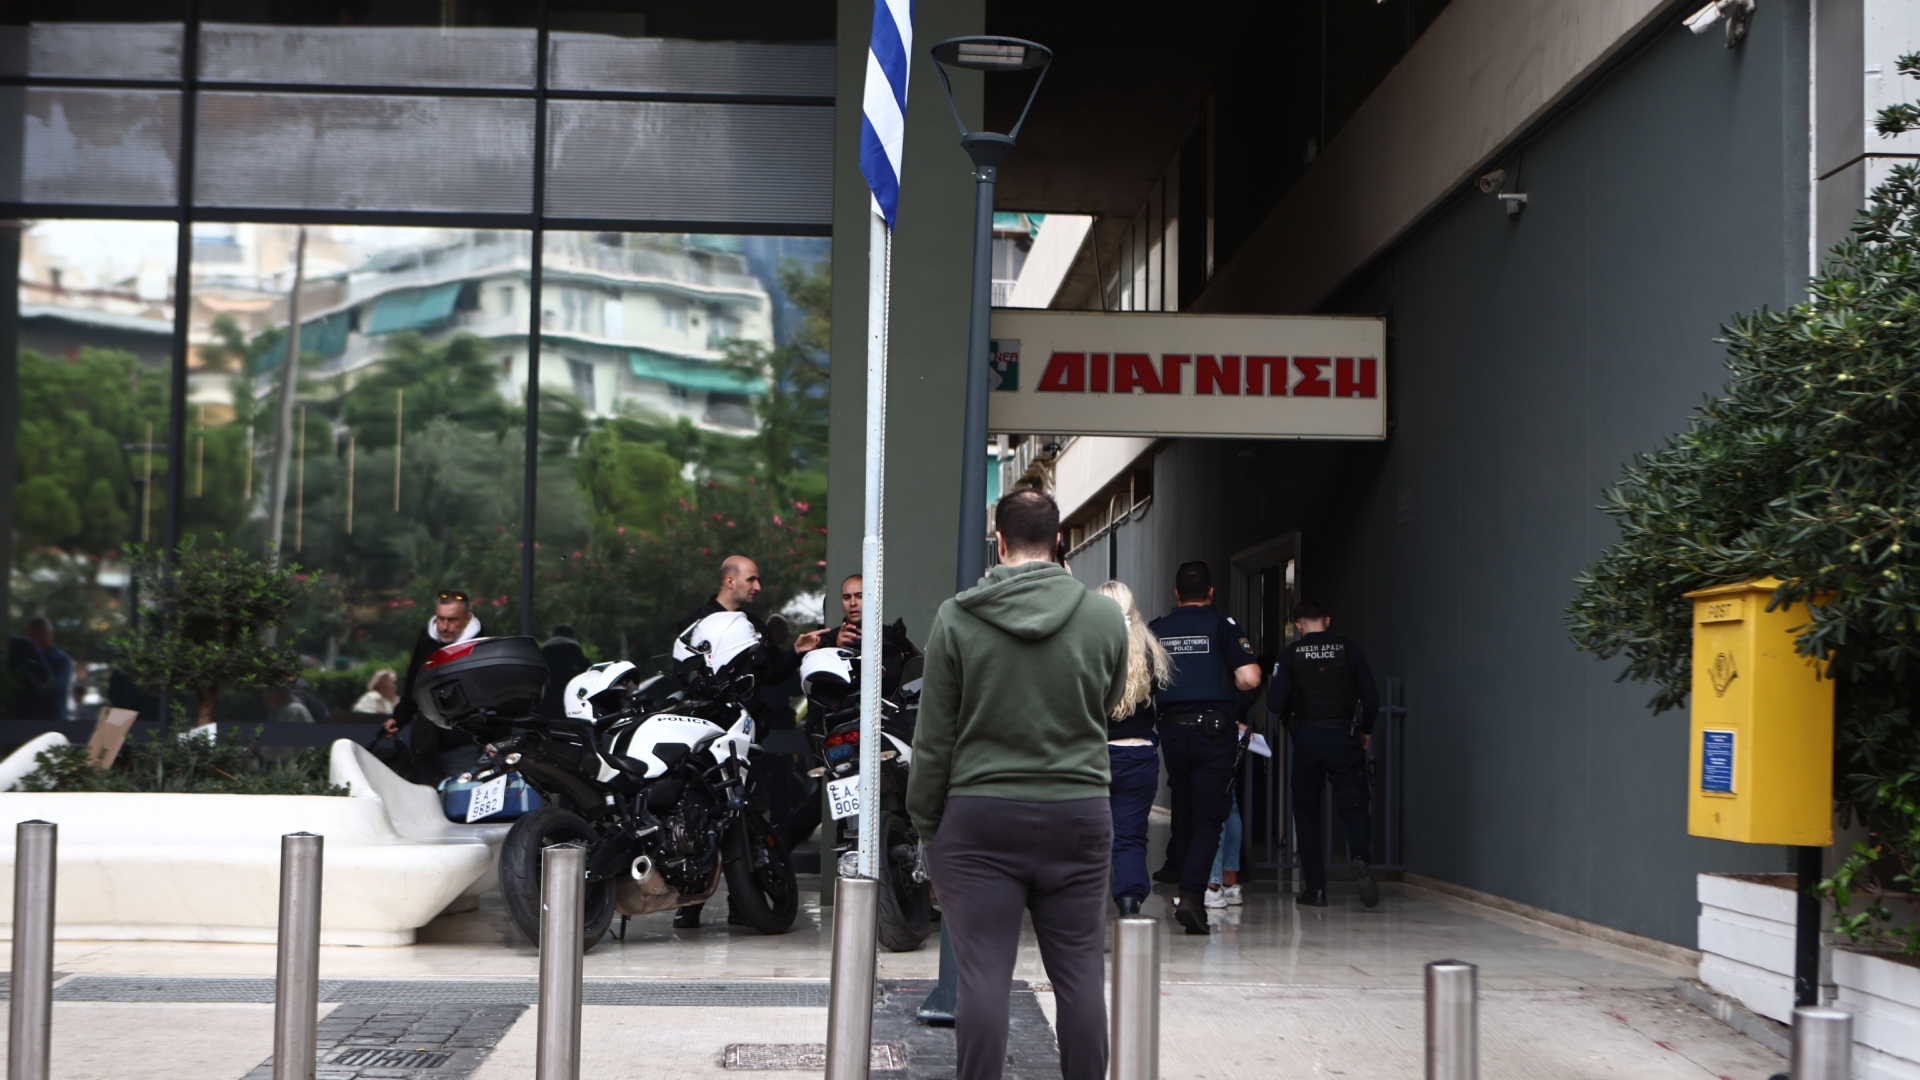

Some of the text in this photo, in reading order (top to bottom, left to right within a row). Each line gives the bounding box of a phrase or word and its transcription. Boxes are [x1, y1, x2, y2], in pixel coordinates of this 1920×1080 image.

[1036, 350, 1378, 399] ΔΙΑΓΝΩΣΗ
[1707, 603, 1733, 618] POST
[1321, 643, 1345, 652] ΔΡΑΣΗ
[1305, 651, 1336, 660] POLICE
[658, 716, 711, 726] POLICE
[472, 798, 497, 818] 9882
[835, 798, 860, 815] 906
